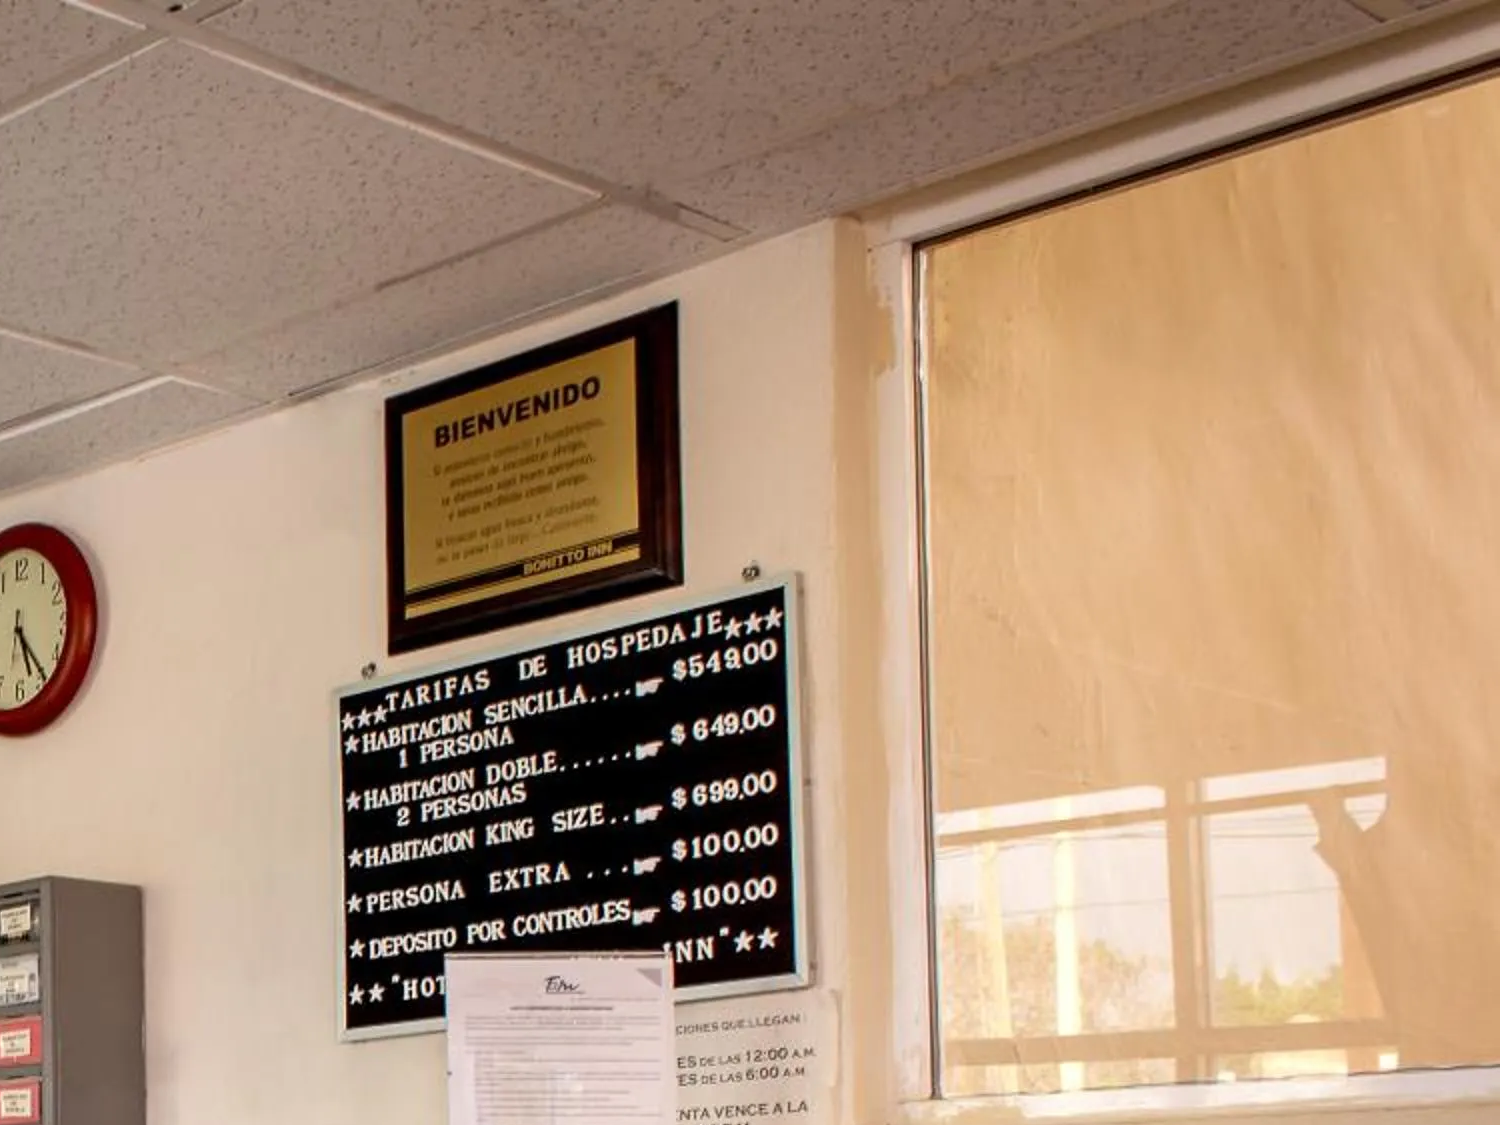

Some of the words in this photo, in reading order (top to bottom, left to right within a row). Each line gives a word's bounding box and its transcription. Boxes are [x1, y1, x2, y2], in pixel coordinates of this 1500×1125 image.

[434, 376, 600, 449] BIENVENIDO
[14, 557, 29, 582] 12
[39, 562, 46, 585] 1
[51, 580, 63, 606] 2
[386, 668, 491, 713] TARIFAS
[518, 655, 548, 681] DE
[567, 610, 724, 669] HOSPEDAJE
[15, 679, 25, 703] 6
[361, 708, 473, 754] HABITACION
[671, 638, 778, 681] $549.00
[399, 748, 409, 769] 1
[420, 726, 515, 764] PERSONA
[363, 768, 476, 811] HABITACION
[396, 806, 411, 827] 2
[421, 782, 528, 822] PERSONAS
[364, 828, 476, 868] HABITACION
[485, 817, 535, 846] KING
[365, 879, 466, 914] PERSONA
[488, 861, 571, 893] EXTRA
[368, 927, 457, 960] DEPOSITO
[466, 919, 506, 945] POR
[512, 899, 632, 937] CONTROLES
[721, 1018, 746, 1031] QUE
[676, 1073, 697, 1087] ES
[701, 1073, 717, 1085] DE
[719, 1071, 743, 1083] LAS
[745, 1066, 780, 1081] 6:00
[699, 1056, 717, 1067] DE
[718, 1054, 741, 1066] LAS
[745, 1047, 789, 1063] 12:00
[676, 1106, 711, 1121] NTA
[713, 1102, 770, 1119] VENCE
[772, 1102, 783, 1116] A
[786, 1100, 809, 1114] LA
